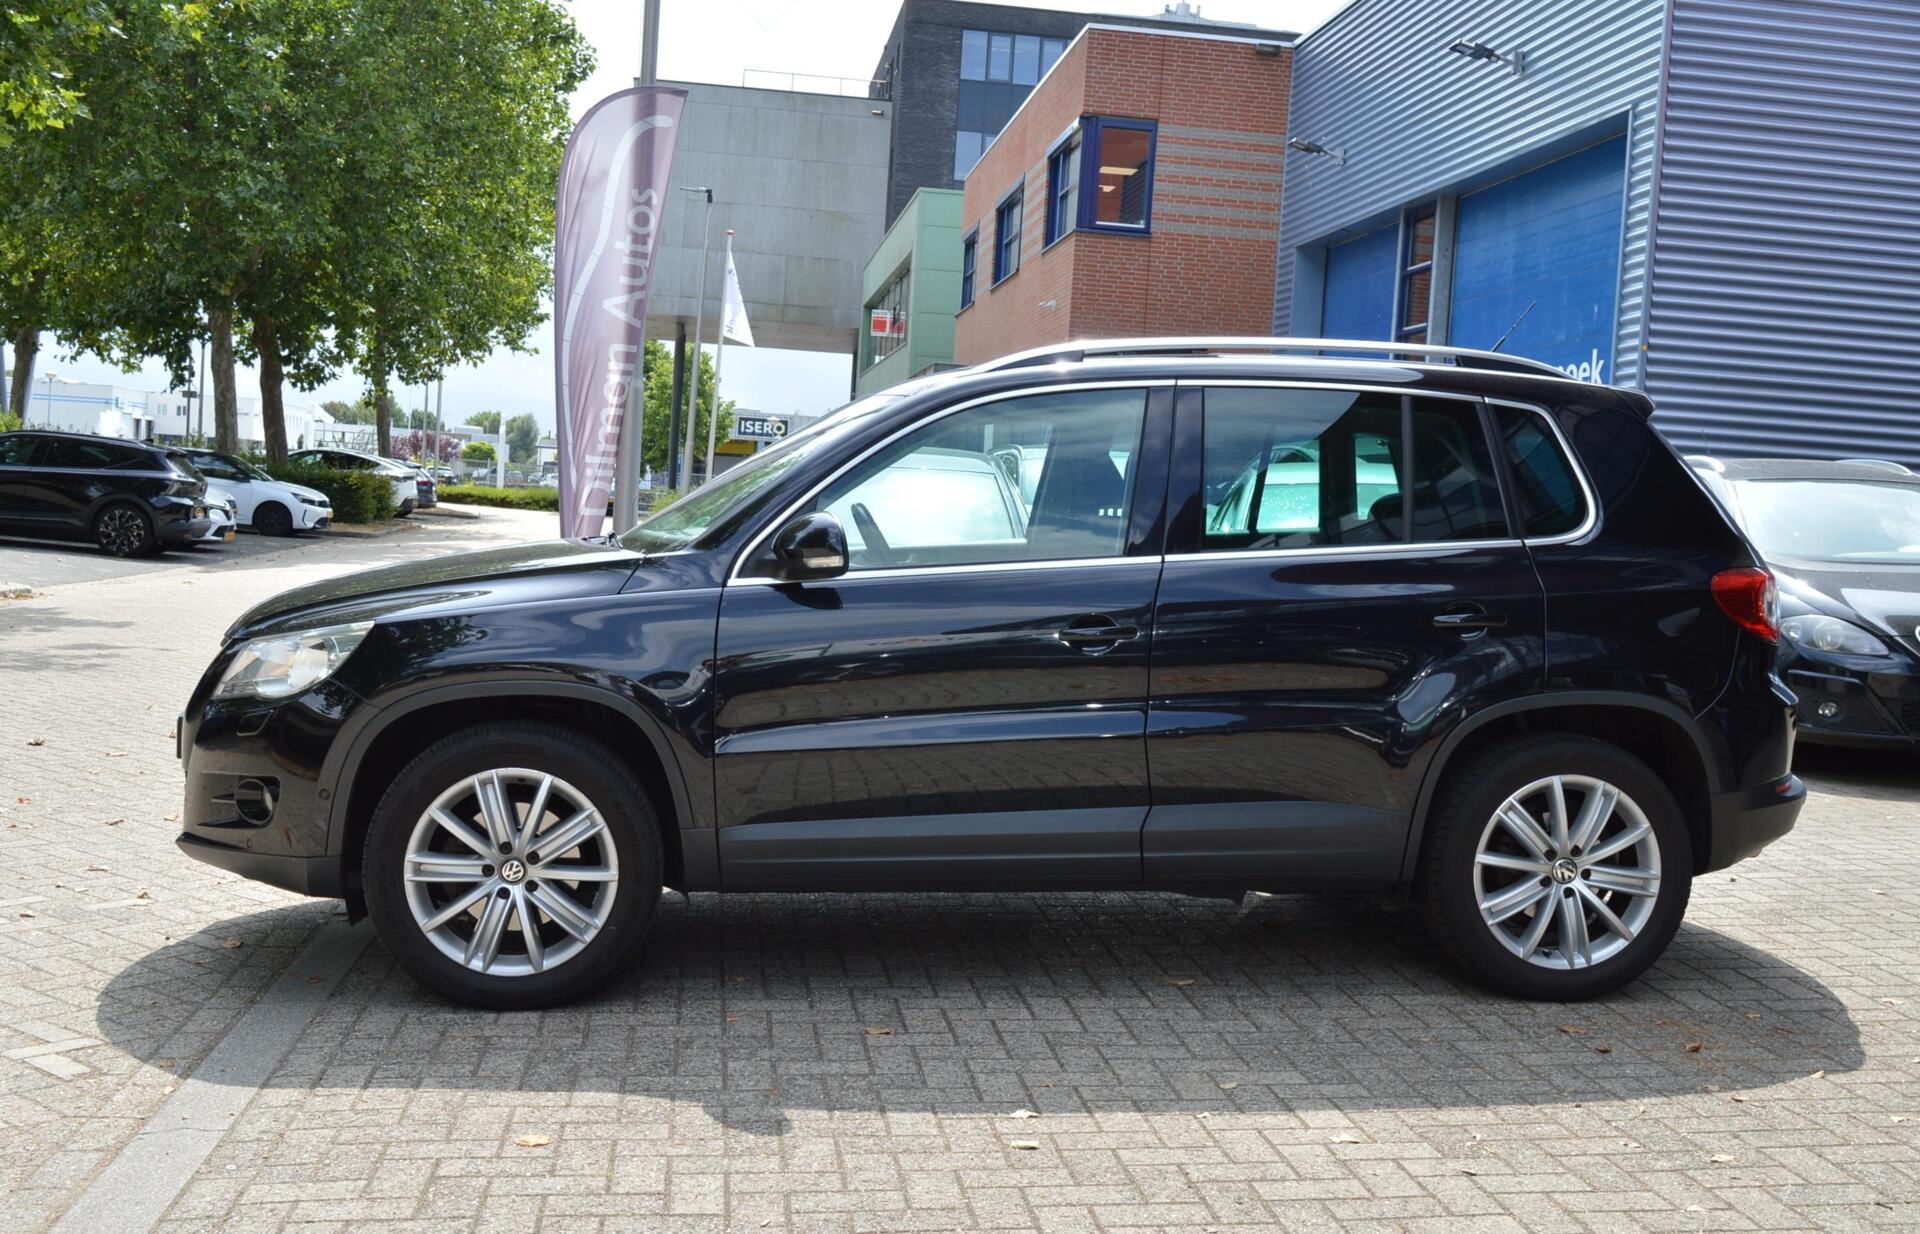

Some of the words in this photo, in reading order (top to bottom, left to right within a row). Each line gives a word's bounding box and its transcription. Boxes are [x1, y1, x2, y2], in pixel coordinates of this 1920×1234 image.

[602, 188, 657, 328] Autos
[1556, 348, 1604, 384] oek
[577, 343, 637, 517] Dilman
[741, 420, 785, 435] ISERO
